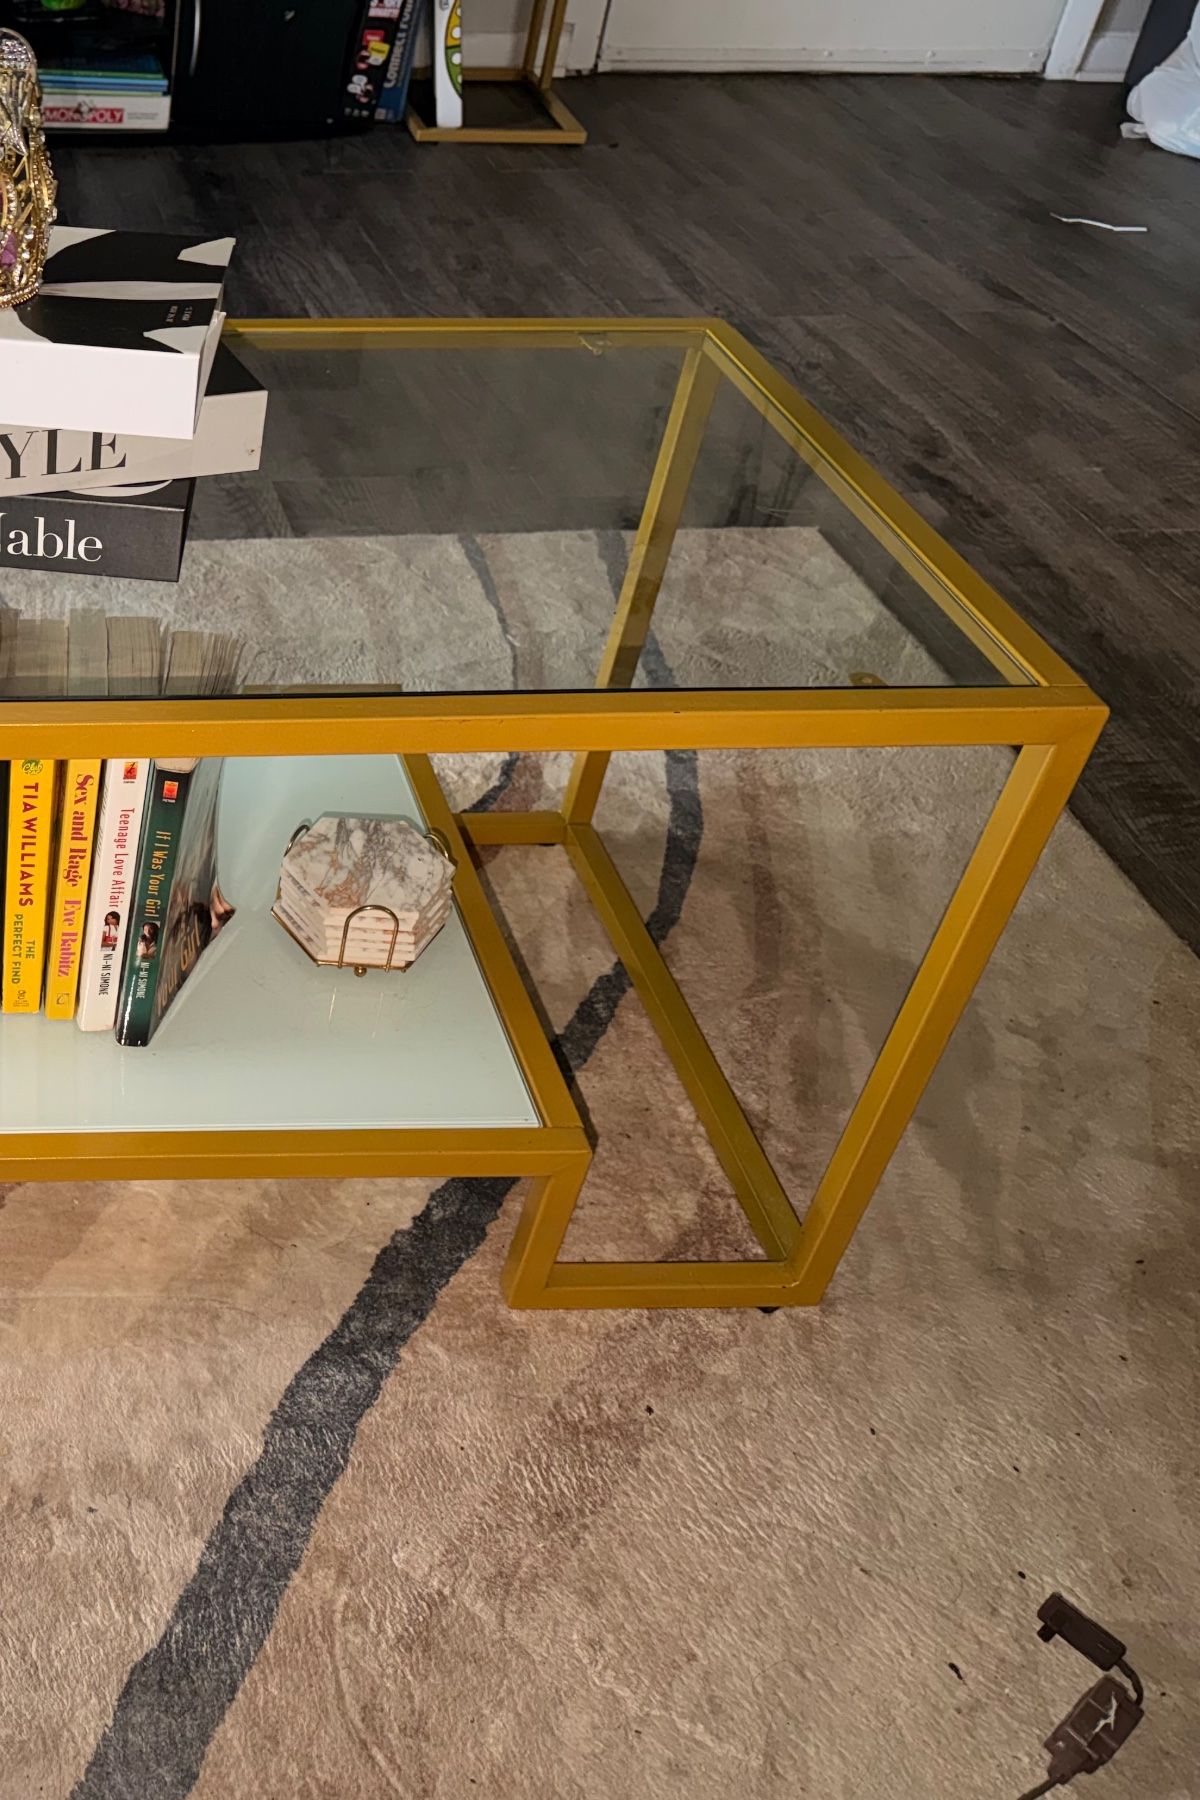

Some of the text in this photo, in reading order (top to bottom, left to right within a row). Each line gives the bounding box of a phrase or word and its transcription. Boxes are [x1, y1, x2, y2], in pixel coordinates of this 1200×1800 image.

[18, 782, 39, 907] TIA WILLIAMS
[155, 830, 172, 841] If
[108, 807, 135, 908] Teenage Love Affair
[151, 850, 169, 870] Was
[57, 773, 95, 978] Sex and Rage Eve Babitz
[147, 873, 166, 896] Your
[143, 898, 161, 918] Girl
[11, 913, 24, 985] PERFECT FIND
[25, 939, 36, 959] THE
[98, 953, 114, 996] NI-NI SIMONE
[135, 978, 148, 999] SIMONE
